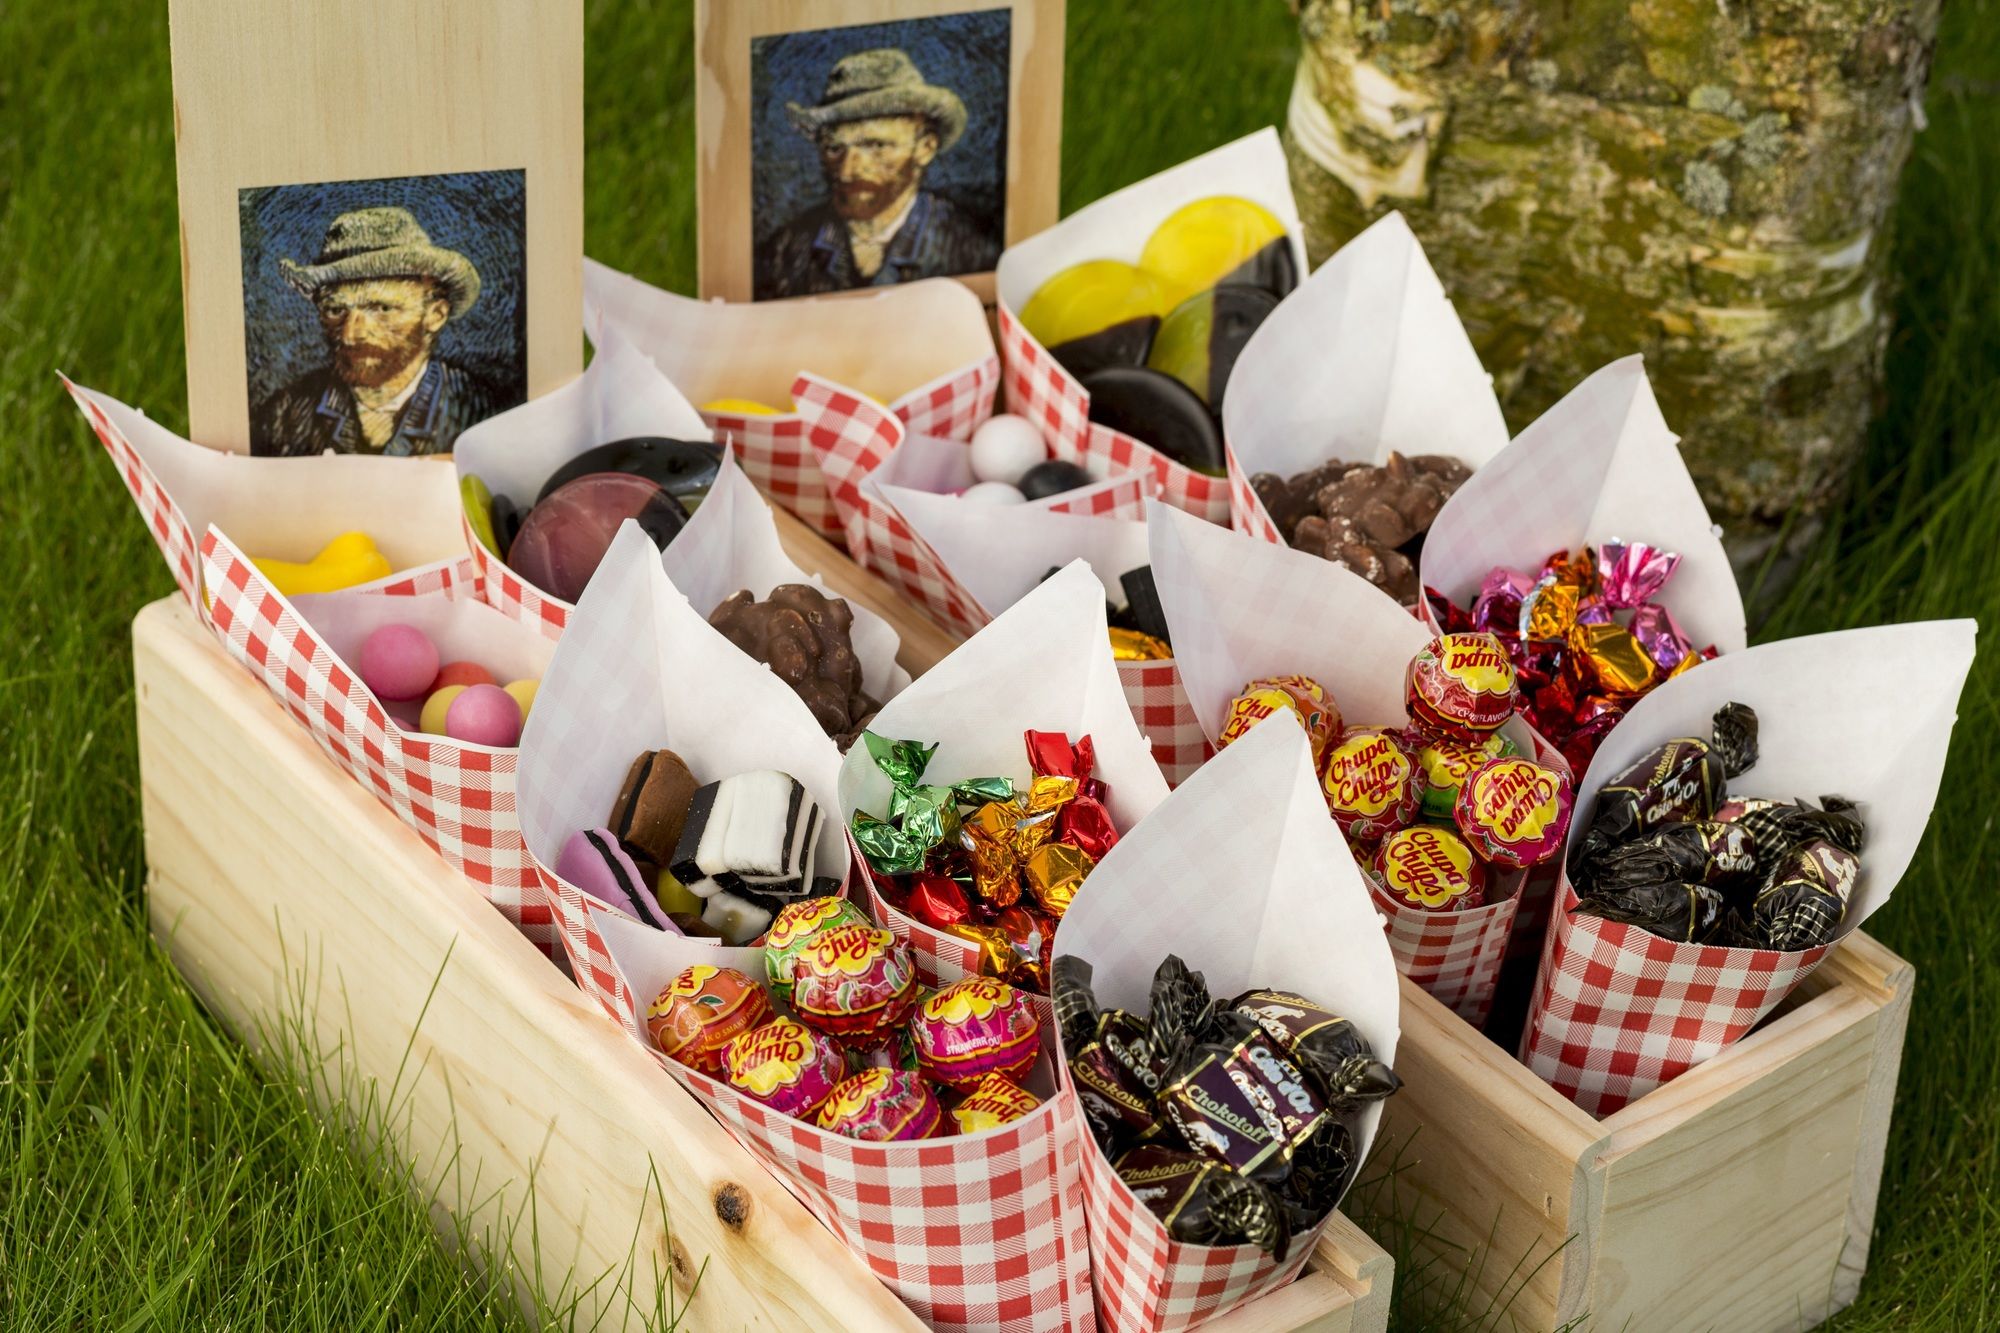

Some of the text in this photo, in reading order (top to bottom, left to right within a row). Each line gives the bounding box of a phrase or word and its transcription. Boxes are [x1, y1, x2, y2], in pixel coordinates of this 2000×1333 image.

[1235, 697, 1275, 720] Chu
[1331, 738, 1390, 784] Chupa
[1338, 757, 1399, 806] Chups
[1482, 764, 1537, 820] Chups
[1501, 778, 1552, 837] Chupa
[1390, 841, 1445, 897] Chups
[1410, 831, 1466, 885] Chupa
[1186, 1084, 1273, 1141] Chokotoff
